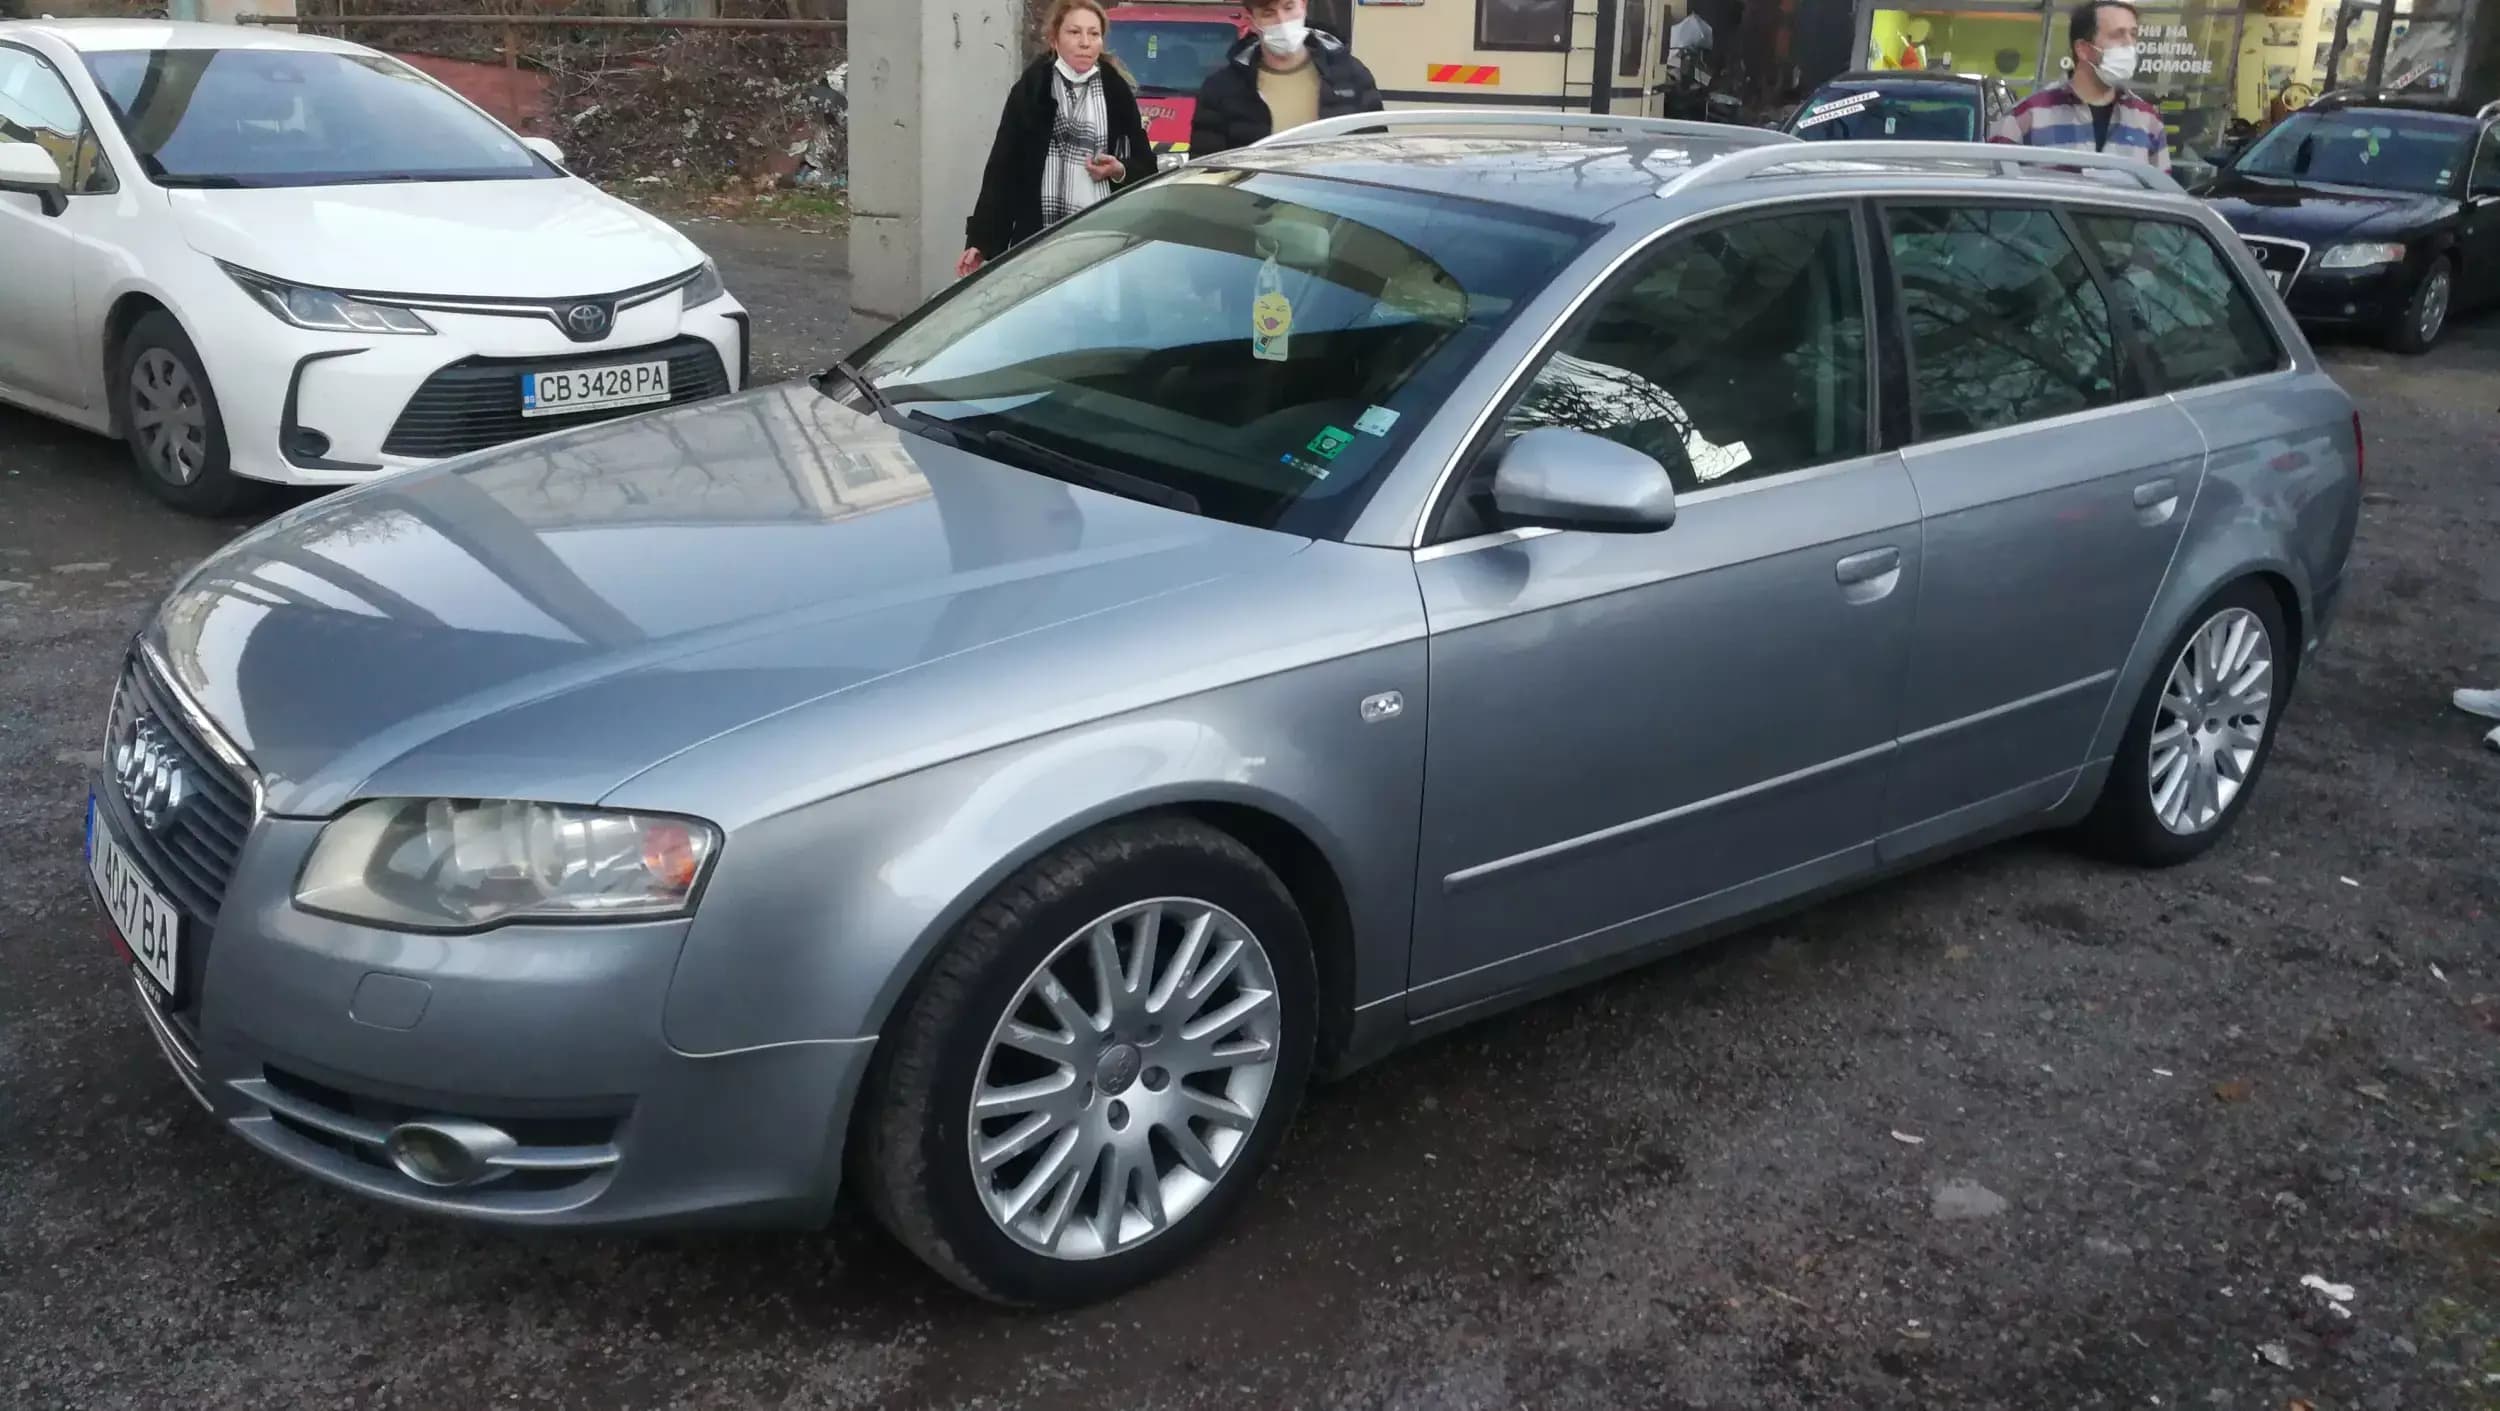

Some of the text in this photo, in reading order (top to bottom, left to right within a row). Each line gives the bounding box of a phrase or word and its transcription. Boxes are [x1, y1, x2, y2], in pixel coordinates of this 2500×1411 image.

[2137, 25, 2188, 38] НИ НА
[2136, 42, 2197, 57] ОБИЛИ,
[2139, 59, 2213, 74] ДОМОВЕ
[540, 366, 664, 402] CB 3428 PA
[105, 841, 139, 934] 4047
[142, 893, 170, 981] BA
